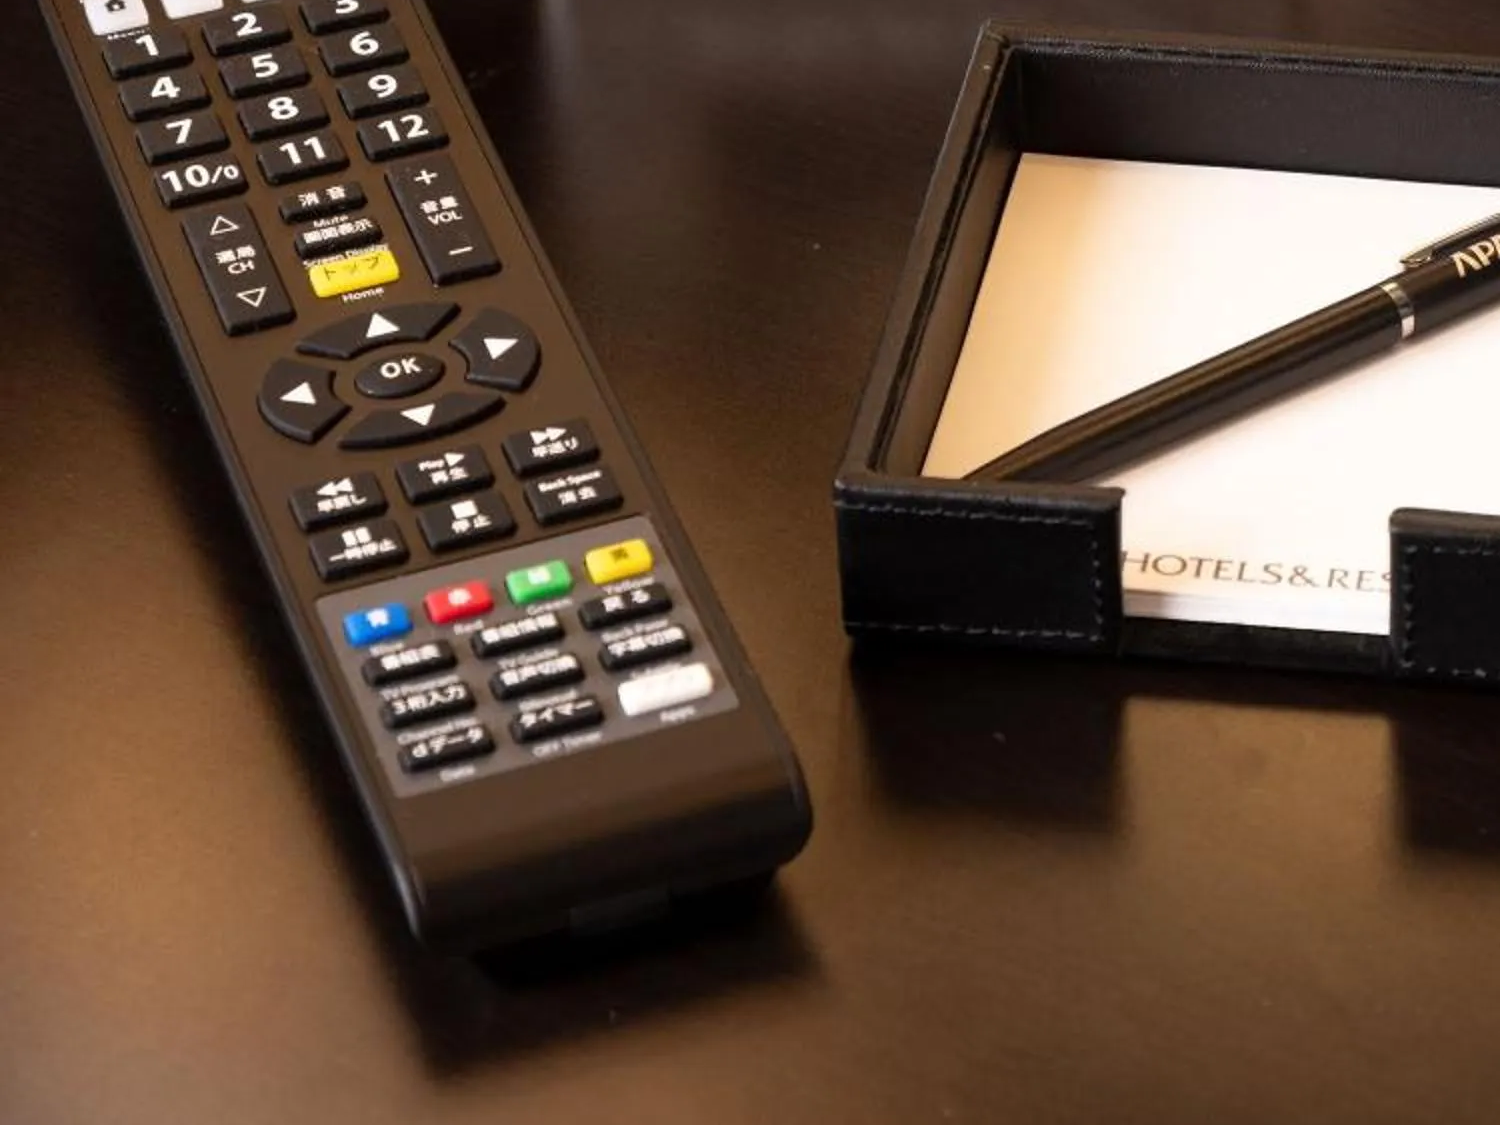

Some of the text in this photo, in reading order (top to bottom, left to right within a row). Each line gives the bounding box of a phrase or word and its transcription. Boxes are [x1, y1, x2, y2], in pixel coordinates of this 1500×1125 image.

[231, 12, 263, 37] 2
[136, 34, 160, 56] 1
[349, 31, 379, 56] 6
[251, 53, 279, 78] 5
[151, 75, 181, 98] 4
[367, 74, 398, 98] 9
[267, 96, 299, 120] 8
[165, 119, 193, 145] 7
[377, 114, 429, 143] 12
[279, 136, 327, 165] 11
[420, 195, 460, 214] 音量
[313, 215, 349, 228] Mute
[427, 211, 463, 225] VOL
[227, 260, 255, 275] CH
[341, 287, 384, 303] Home
[380, 357, 422, 379] OK
[520, 699, 596, 728] タイマー
